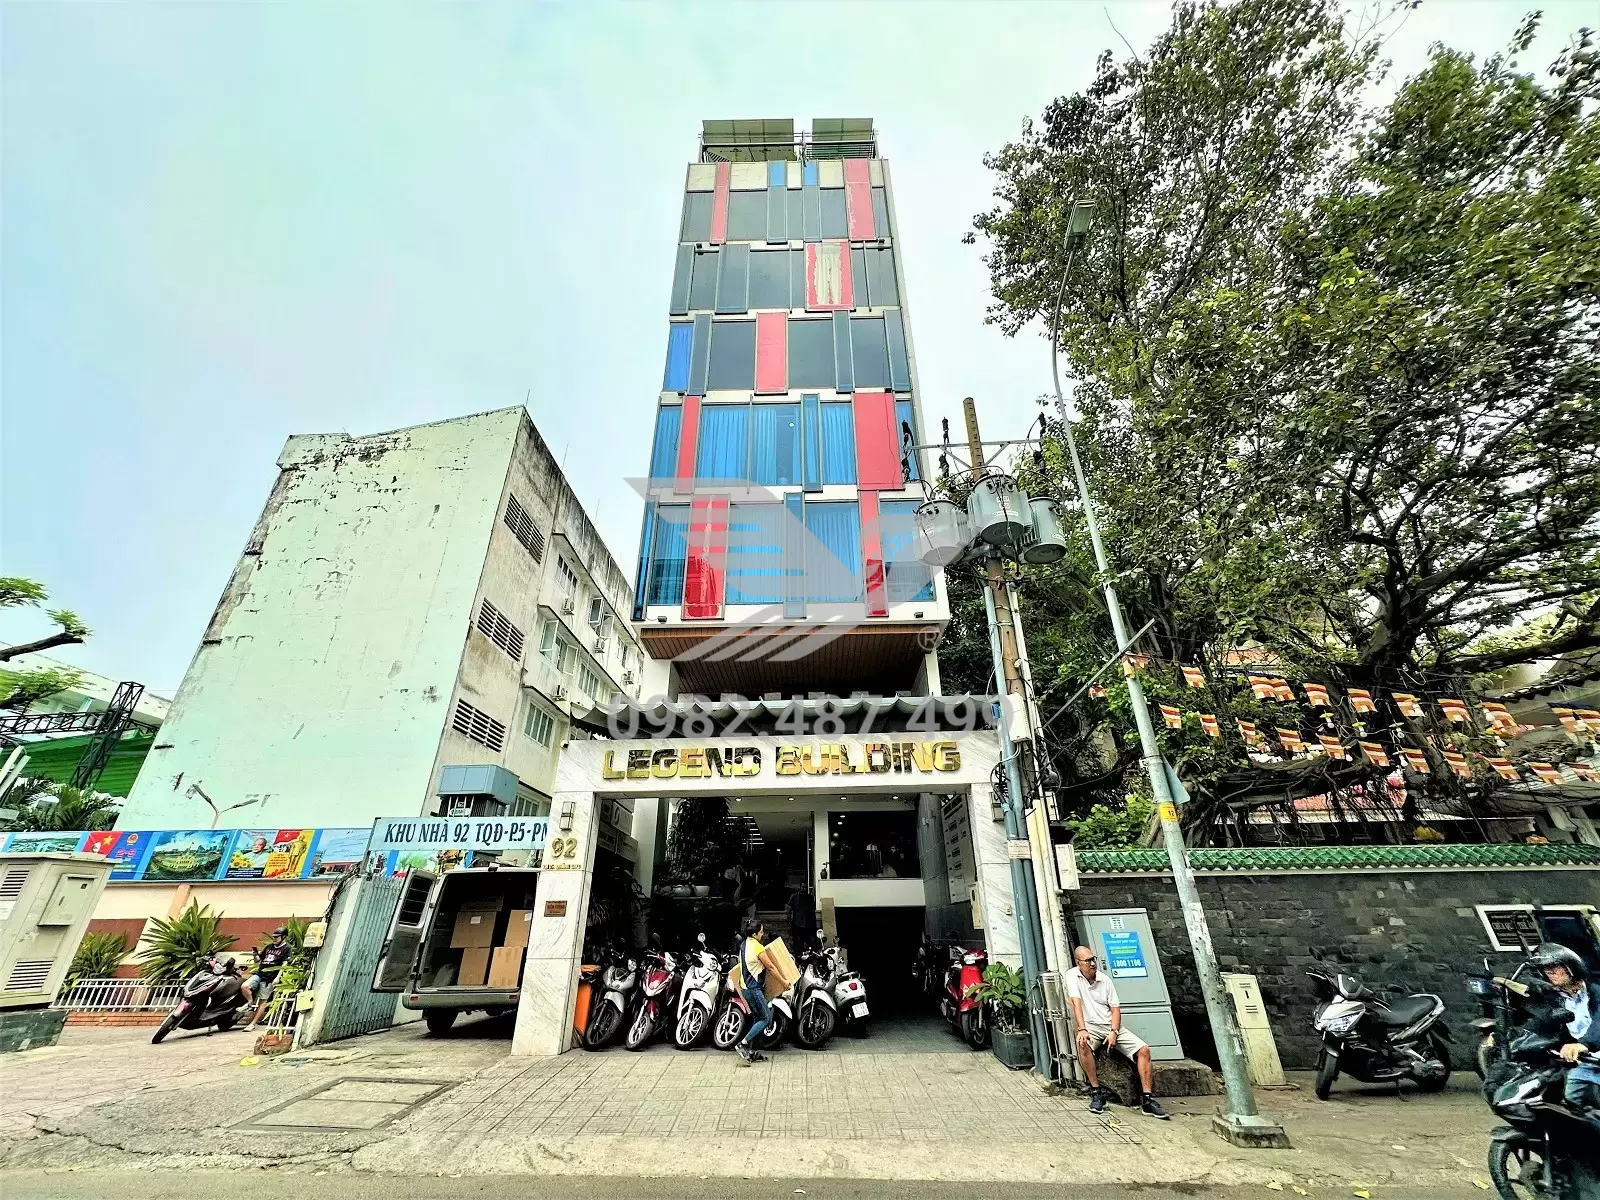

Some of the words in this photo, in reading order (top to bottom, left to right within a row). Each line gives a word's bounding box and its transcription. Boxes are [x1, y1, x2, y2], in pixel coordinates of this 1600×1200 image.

[603, 747, 762, 779] LEGEND
[775, 741, 961, 776] BUILDING
[384, 822, 416, 843] KHU
[418, 819, 449, 843] NHÀ
[453, 823, 469, 843] 92
[551, 837, 578, 858] 92
